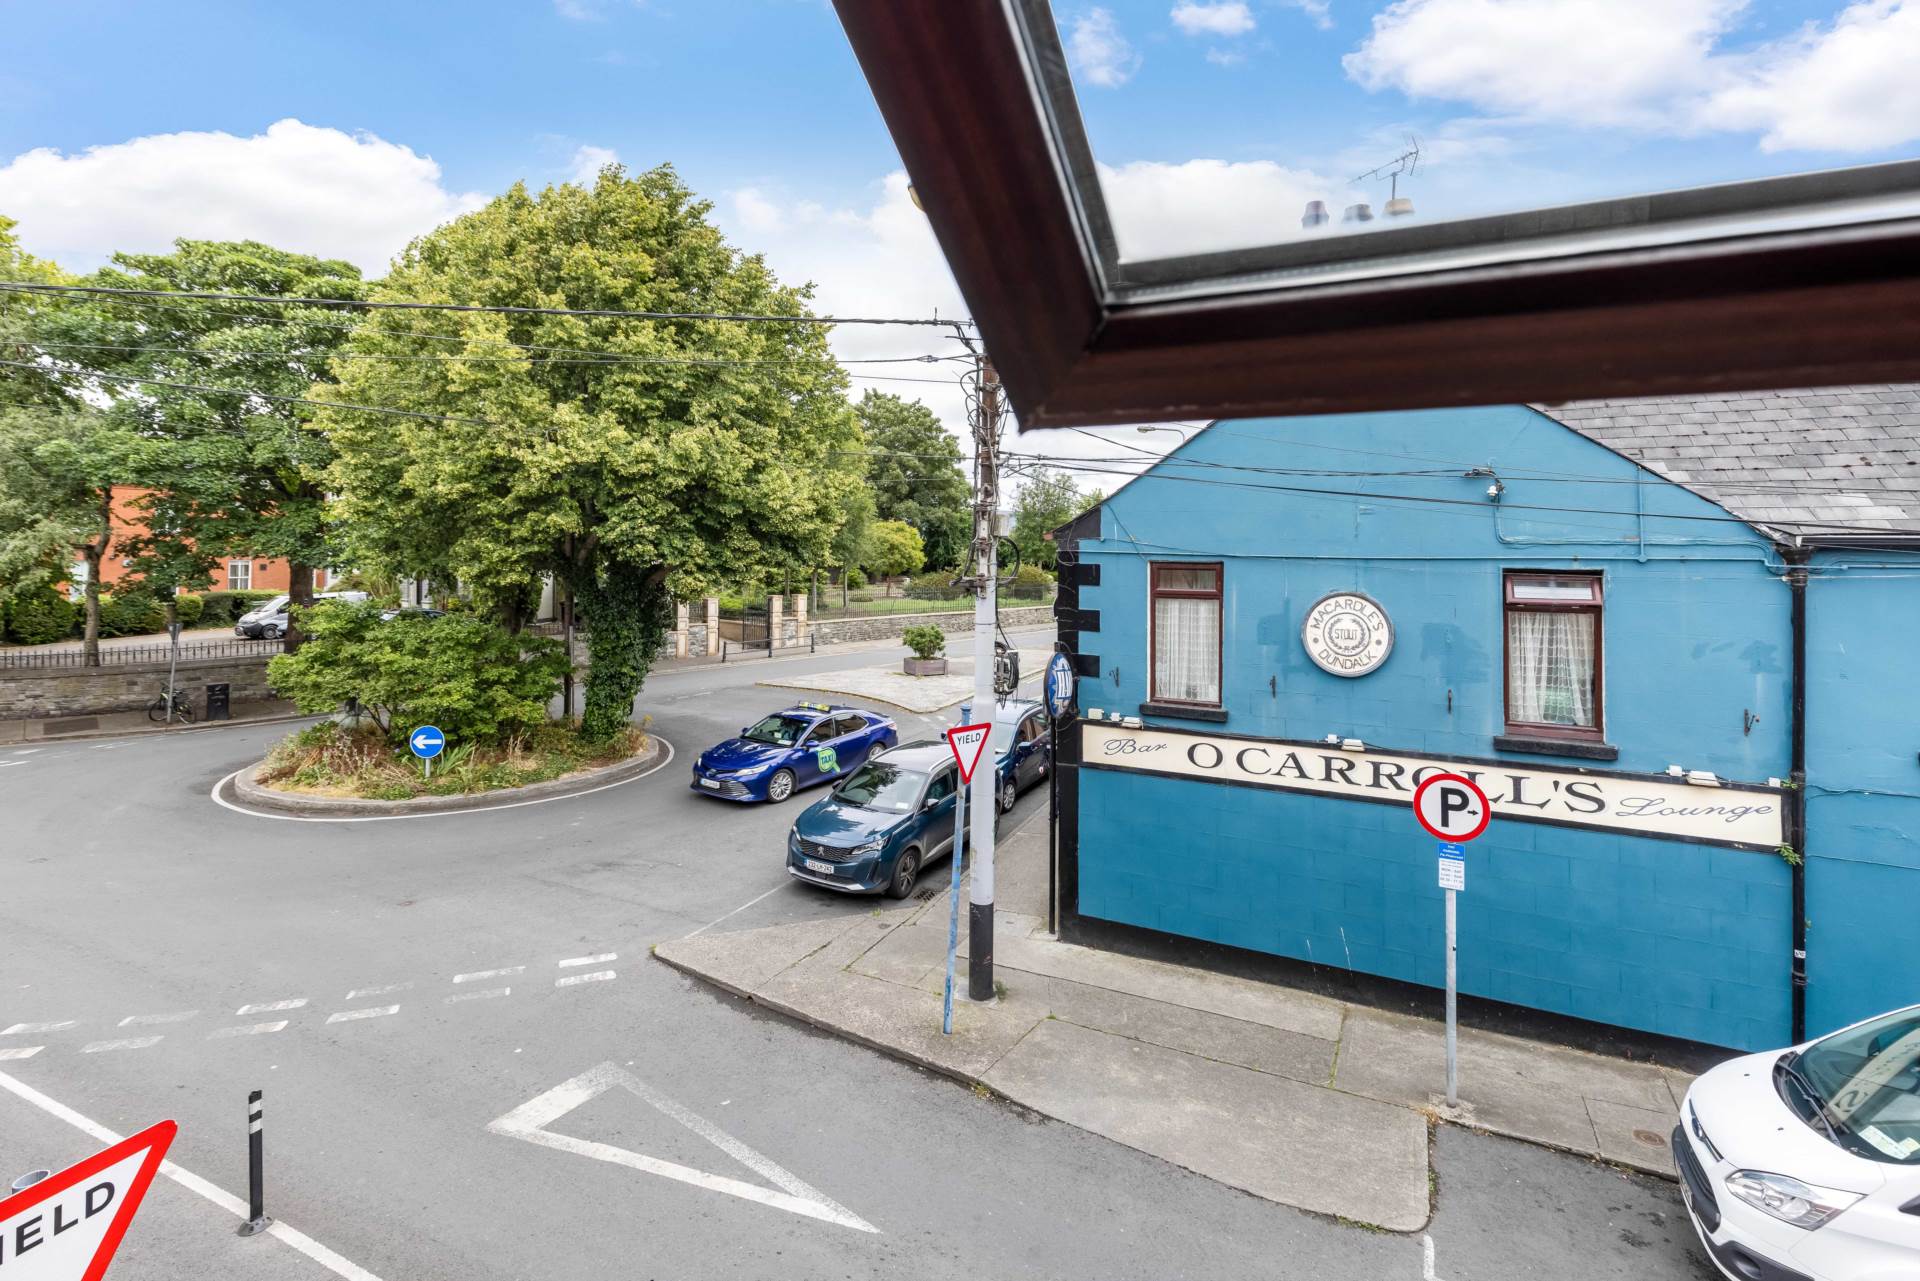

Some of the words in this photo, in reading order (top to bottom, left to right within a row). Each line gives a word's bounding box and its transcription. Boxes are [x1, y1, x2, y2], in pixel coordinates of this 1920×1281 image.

[1335, 628, 1358, 641] STOUT
[1318, 648, 1377, 670] DUNDALK
[957, 732, 981, 746] YIELD
[821, 753, 833, 765] TAXI
[1103, 738, 1168, 756] Bar
[1615, 797, 1773, 823] Lounge
[1440, 787, 1470, 828] P
